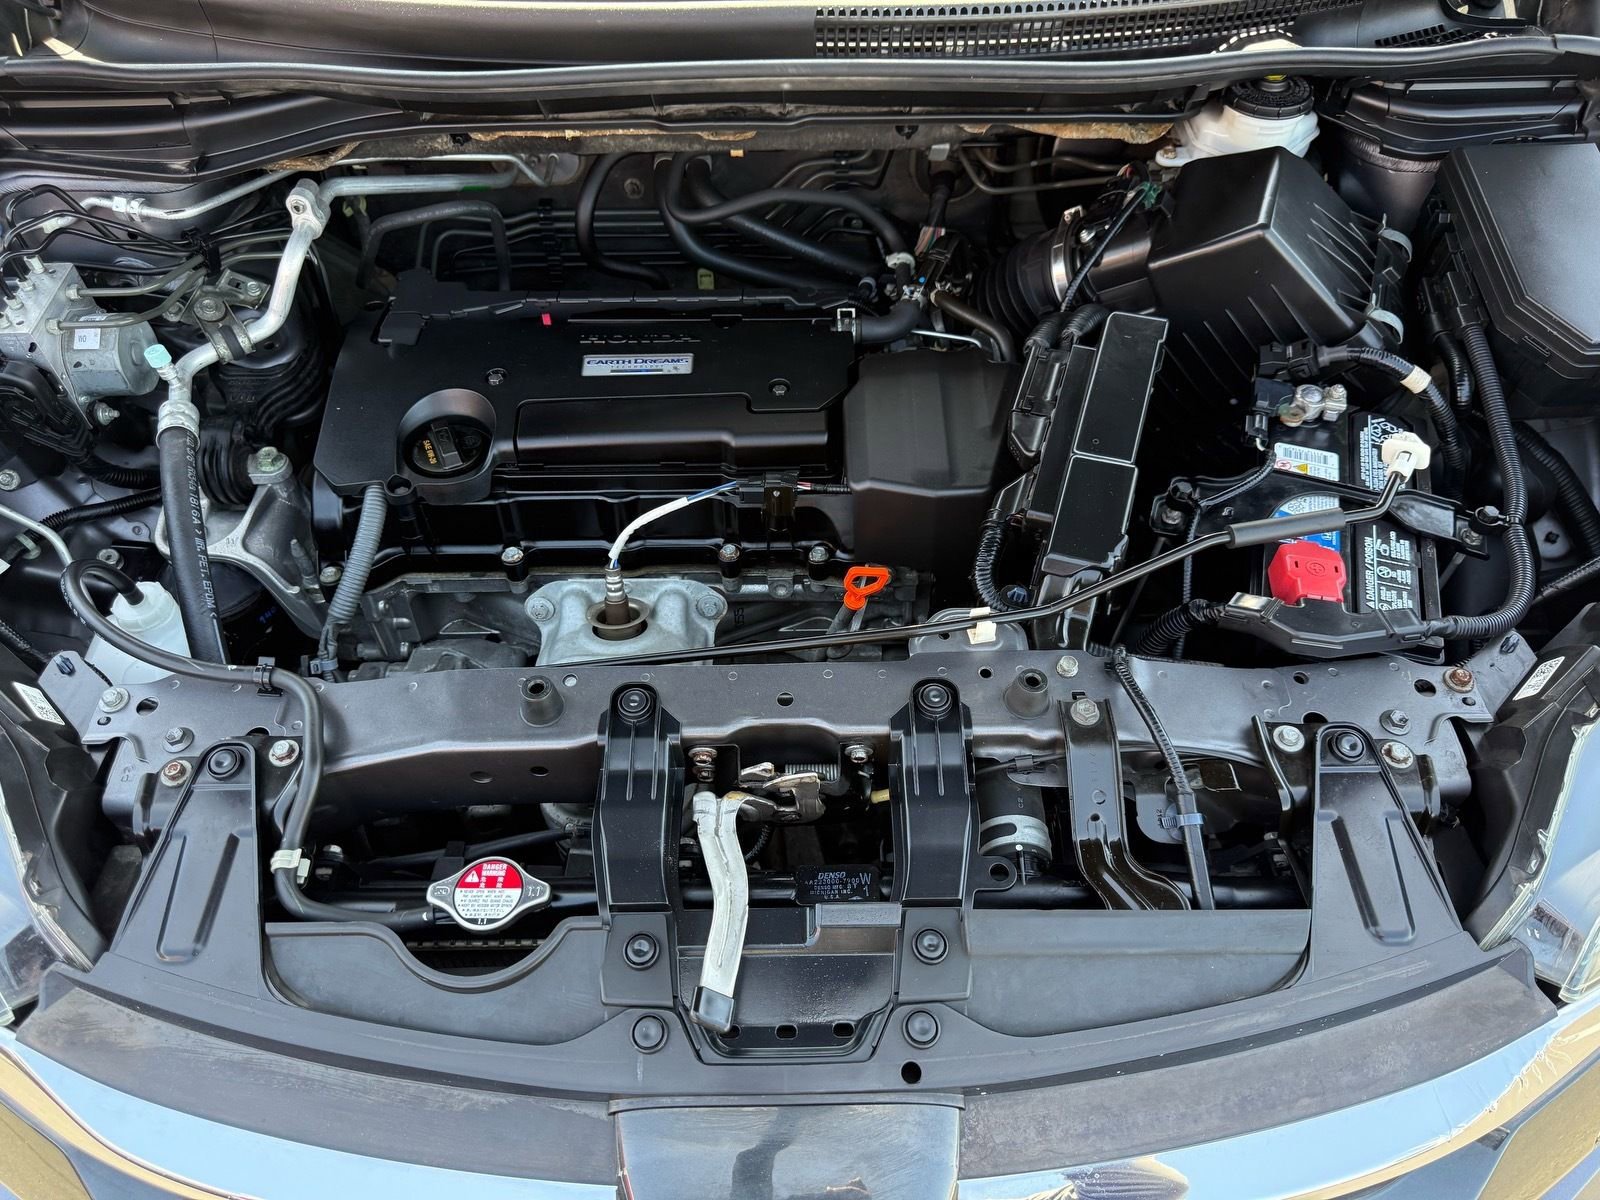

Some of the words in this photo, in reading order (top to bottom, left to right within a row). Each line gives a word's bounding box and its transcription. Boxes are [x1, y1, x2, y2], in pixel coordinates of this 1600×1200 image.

[634, 357, 689, 365] DREAMS
[1364, 536, 1374, 564] POISON
[1365, 569, 1375, 601] DANGER
[203, 580, 216, 608] EPDM
[482, 863, 508, 871] DANGER
[818, 871, 846, 880] DENSO
[859, 872, 872, 885] W
